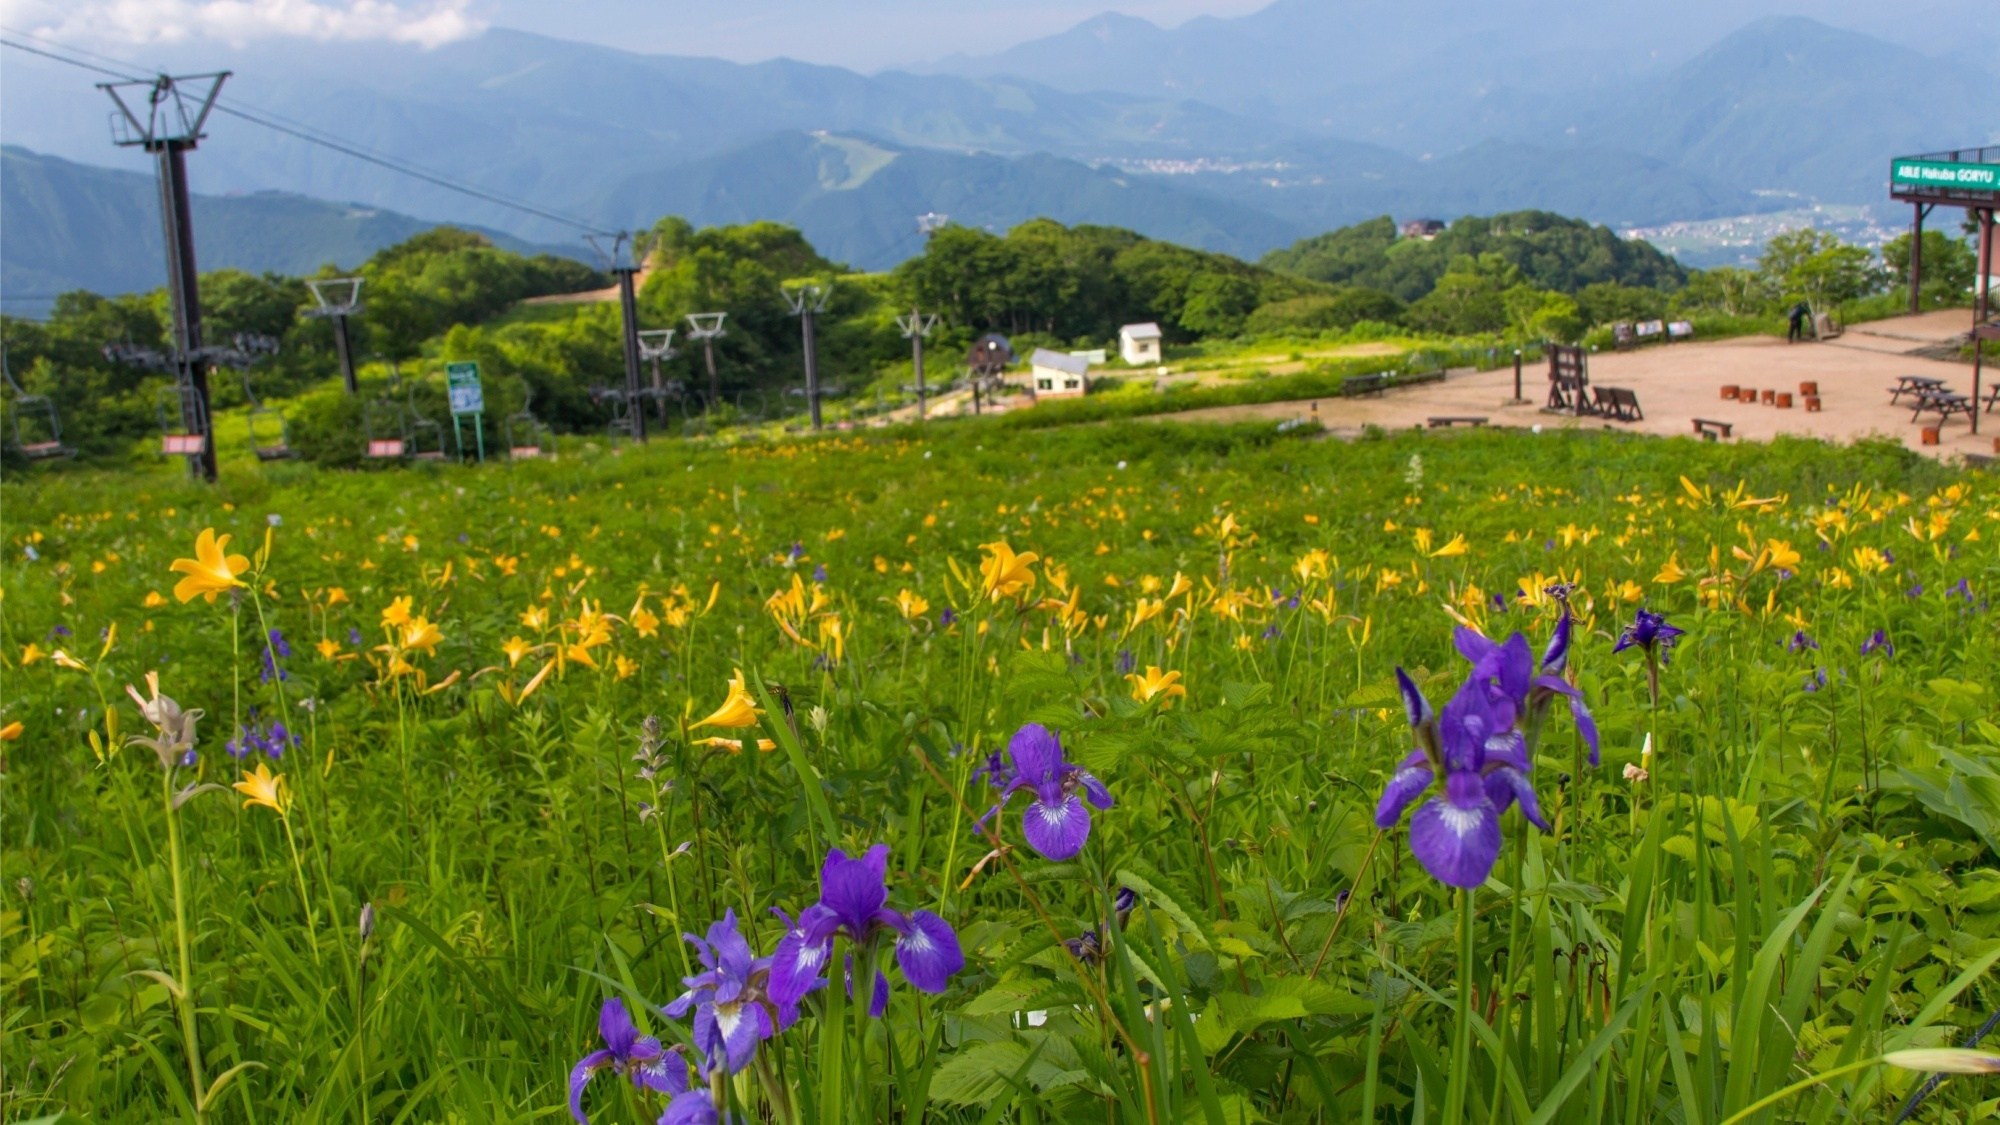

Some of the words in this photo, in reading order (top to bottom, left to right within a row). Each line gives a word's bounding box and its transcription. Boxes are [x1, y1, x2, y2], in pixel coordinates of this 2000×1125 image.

[1898, 166, 1920, 178] ABLE
[1922, 167, 1955, 181] Hakuba
[1957, 168, 1994, 183] GORYU
